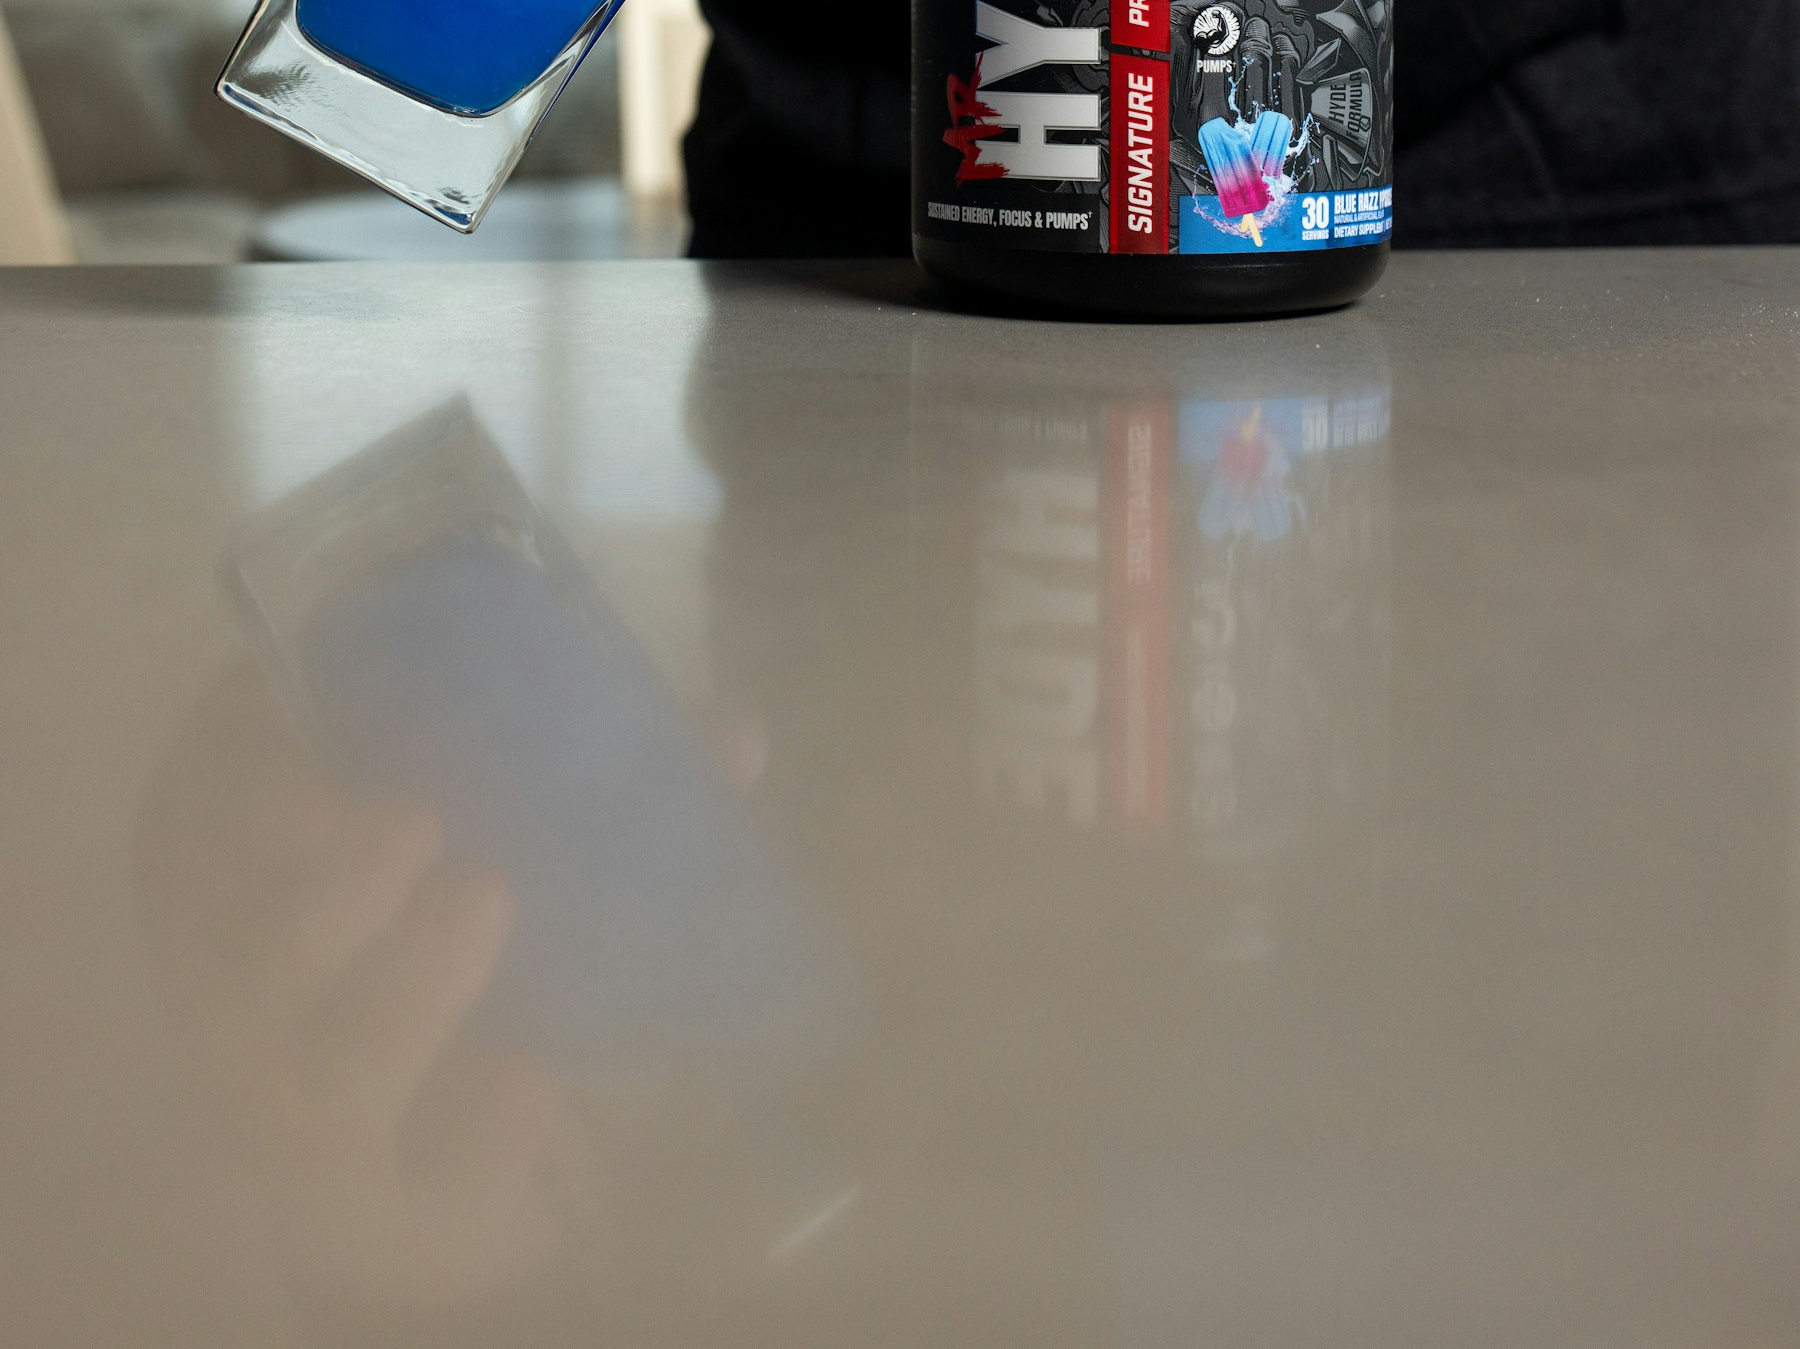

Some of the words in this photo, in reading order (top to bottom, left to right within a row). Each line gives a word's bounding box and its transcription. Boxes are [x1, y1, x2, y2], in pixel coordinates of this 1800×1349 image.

[1328, 83, 1346, 125] HYDE
[1346, 71, 1363, 141] FORMULA
[1128, 72, 1154, 234] SIGNATURE
[928, 202, 960, 222] SUSTAINED
[961, 205, 997, 227] ENERGY,
[999, 209, 1032, 228] FOCUS
[1035, 211, 1043, 228] &
[1302, 196, 1330, 230] 30
[1334, 193, 1357, 215] BLUE
[1358, 191, 1379, 212] RAZZ
[1302, 230, 1330, 241] SERVINGS
[1334, 224, 1358, 239] DIETARY
